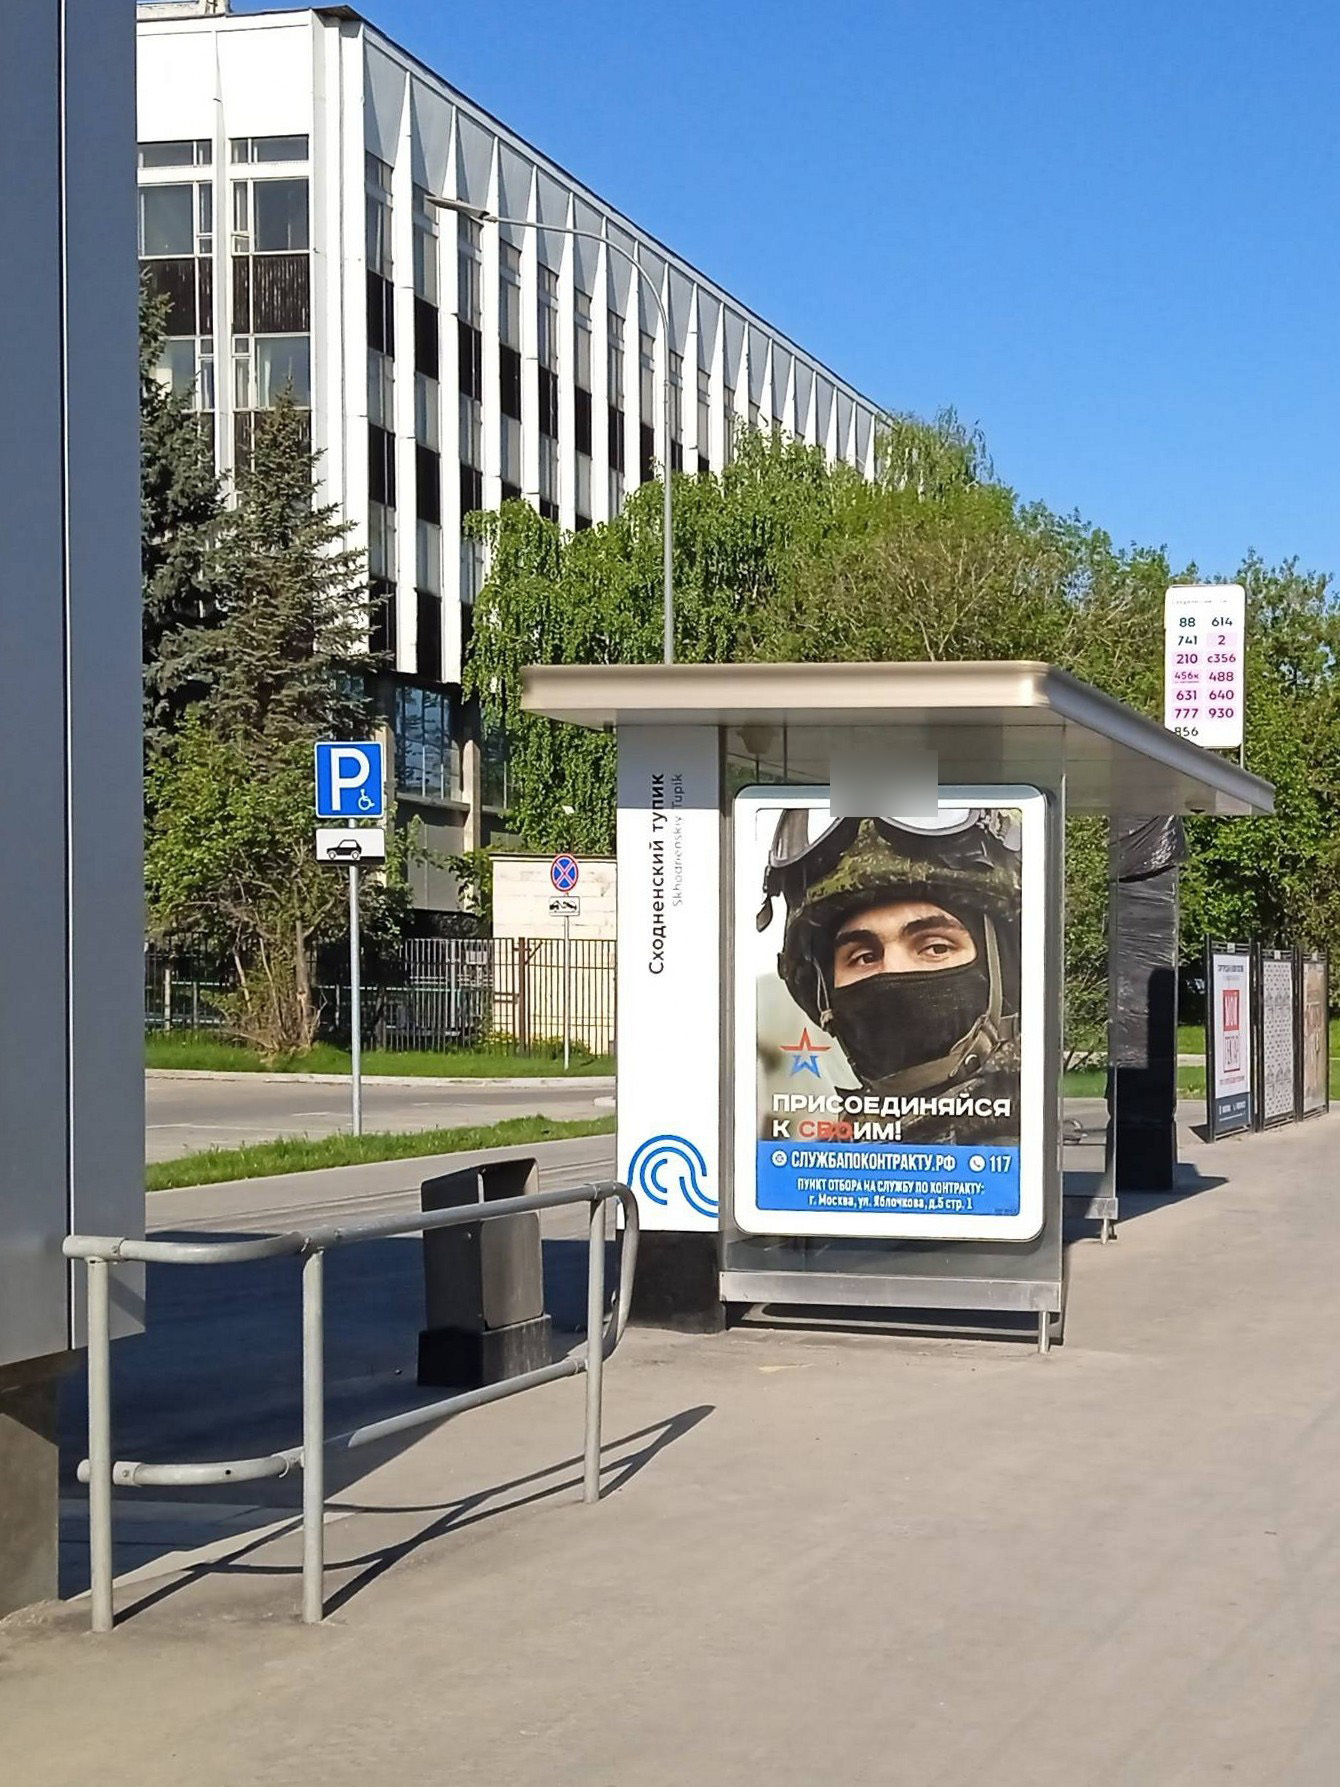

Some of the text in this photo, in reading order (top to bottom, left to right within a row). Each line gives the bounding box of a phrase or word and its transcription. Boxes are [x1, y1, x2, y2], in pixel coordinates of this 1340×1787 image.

[1178, 617, 1196, 628] 88
[1211, 616, 1233, 627] 614
[1177, 635, 1198, 646] 741
[1218, 635, 1226, 645] 2
[1176, 654, 1198, 665] 210
[1207, 654, 1236, 664] с356
[1174, 671, 1200, 680] 456к
[1208, 672, 1235, 682] 488
[1176, 690, 1197, 701] 631
[1208, 689, 1235, 700] 640
[1174, 708, 1199, 719] 777
[1208, 708, 1235, 719] 930
[1174, 726, 1199, 737] 856
[331, 748, 370, 811] P
[671, 773, 685, 809] Tupik
[648, 773, 667, 975] Сходненский тупик
[772, 1092, 1011, 1119] ПРИСОЕДИНЯЙСЯ
[772, 1119, 903, 1141] К СВОИМ!
[791, 1150, 957, 1172] СЛУЖБАПОКОНТРАКТУ.РФ
[989, 1155, 1012, 1173] 117
[797, 1177, 985, 1195] ПУНКТ ОТБОРА НА СЛУЖБУ ПО КОНТРАКТУ:
[809, 1194, 817, 1206] г.
[818, 1193, 857, 1208] Москва,
[857, 1196, 872, 1209] ул.
[873, 1195, 928, 1210] Яблочкова,
[945, 1199, 965, 1212] стр.
[966, 1197, 974, 1210] 1
